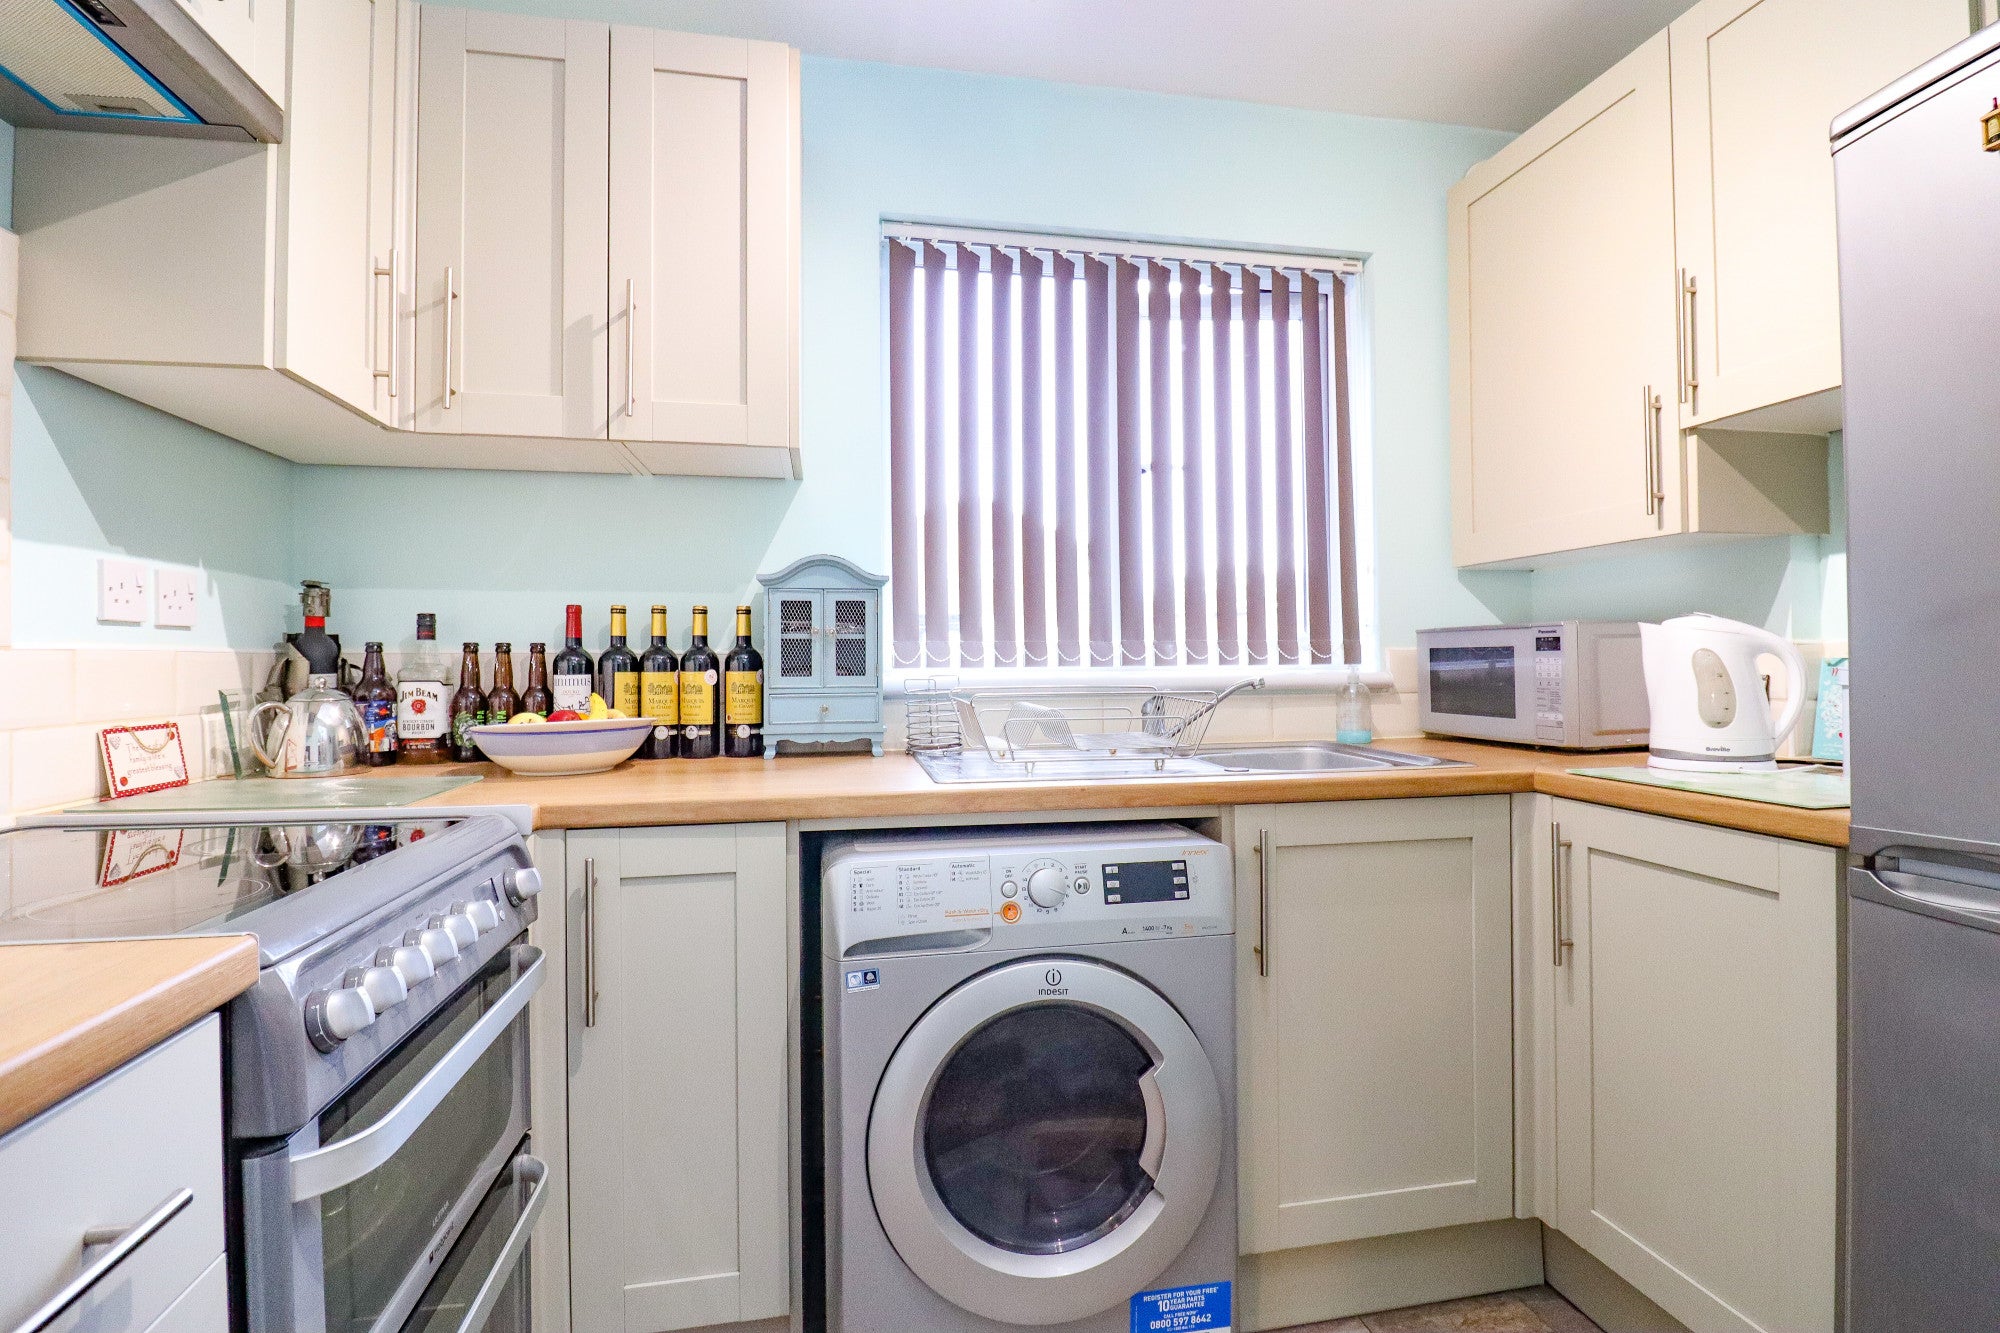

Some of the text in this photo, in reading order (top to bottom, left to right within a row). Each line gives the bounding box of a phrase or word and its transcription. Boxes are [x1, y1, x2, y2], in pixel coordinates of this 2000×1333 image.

[400, 688, 438, 702] JIM BEAM
[1143, 1293, 1172, 1302] REGISTER
[1186, 1294, 1205, 1302] PARTS
[1158, 1300, 1170, 1312] 10
[1170, 1301, 1205, 1310] GUARANTEE
[1150, 1320, 1172, 1330] 0800
[1173, 1316, 1189, 1326] 597
[1190, 1314, 1212, 1324] 8642
